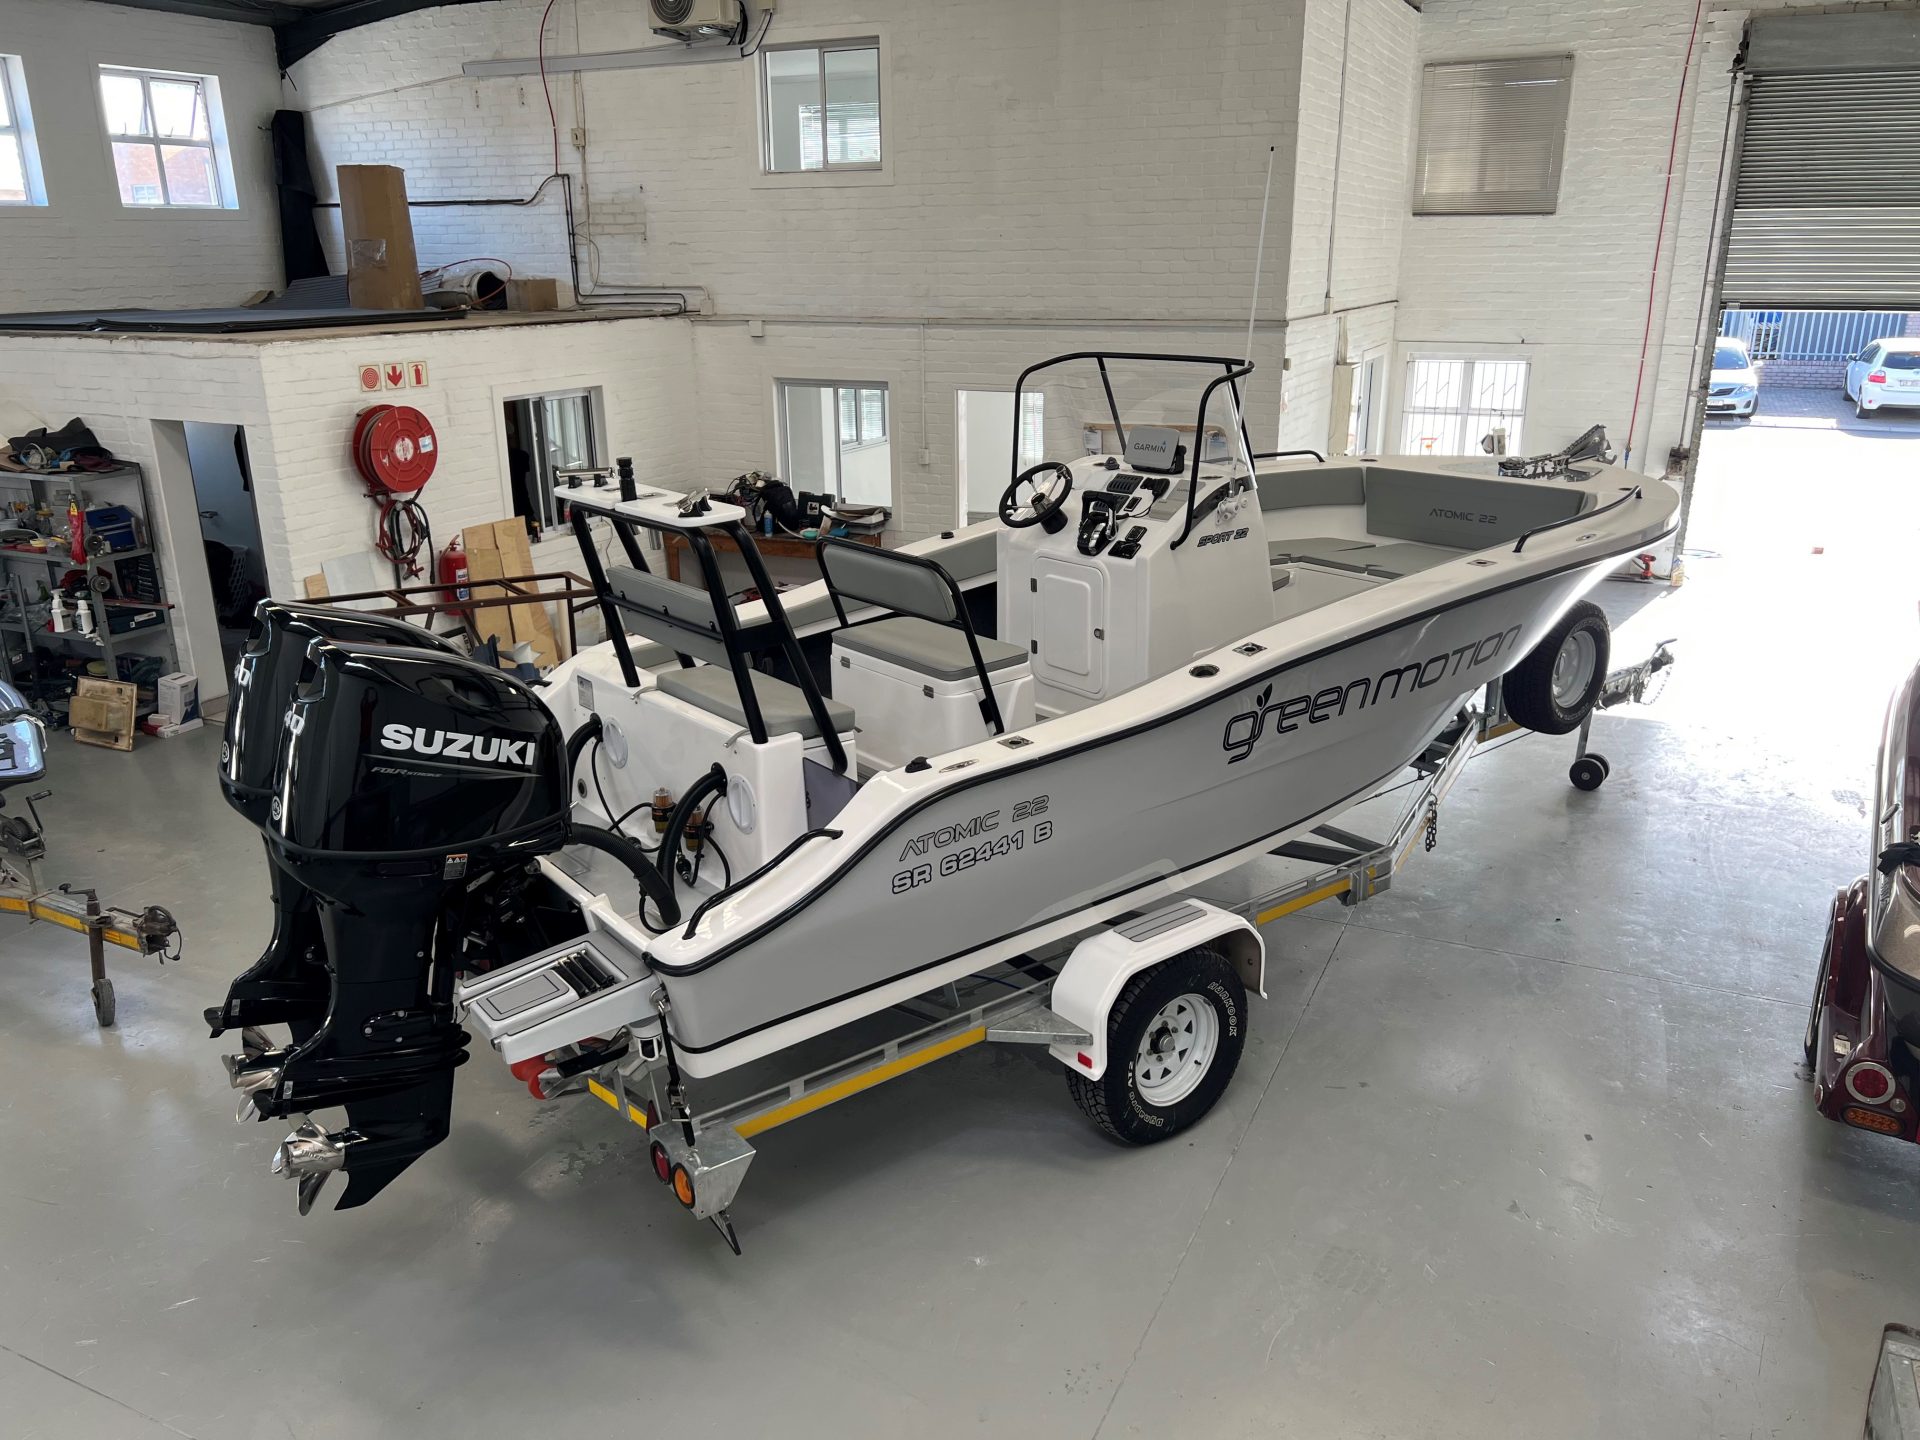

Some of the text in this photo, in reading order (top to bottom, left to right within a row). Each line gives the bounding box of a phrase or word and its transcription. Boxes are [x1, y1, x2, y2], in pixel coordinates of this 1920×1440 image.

[1133, 442, 1167, 453] GARMIN
[1429, 508, 1498, 525] ATOMIC 22
[1197, 527, 1250, 547] SPORT 22
[284, 710, 305, 735] 40
[380, 723, 536, 766] SUZUKI
[899, 795, 1050, 862] ATOMIC 22
[892, 821, 1053, 894] SR 62441 B
